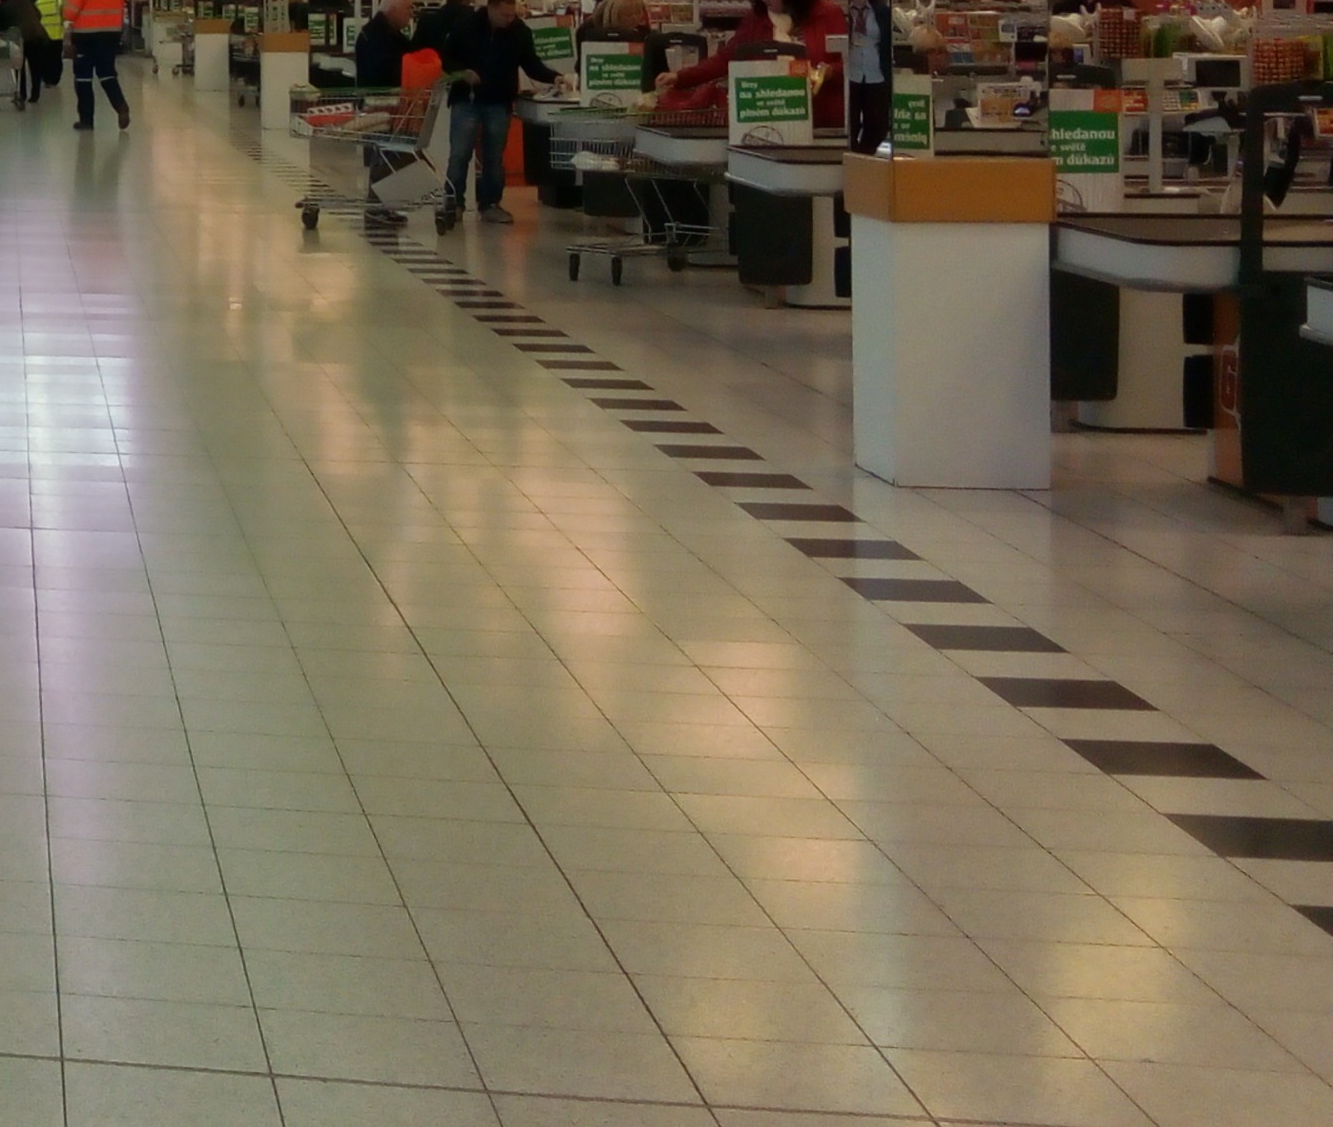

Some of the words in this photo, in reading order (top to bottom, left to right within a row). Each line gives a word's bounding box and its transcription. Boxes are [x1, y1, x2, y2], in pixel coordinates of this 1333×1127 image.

[739, 91, 752, 99] na
[755, 89, 806, 99] shledanou
[739, 107, 770, 120] plném
[771, 105, 806, 116] důkazů
[1050, 127, 1116, 140] hledanou
[1067, 152, 1116, 166] důkazů
